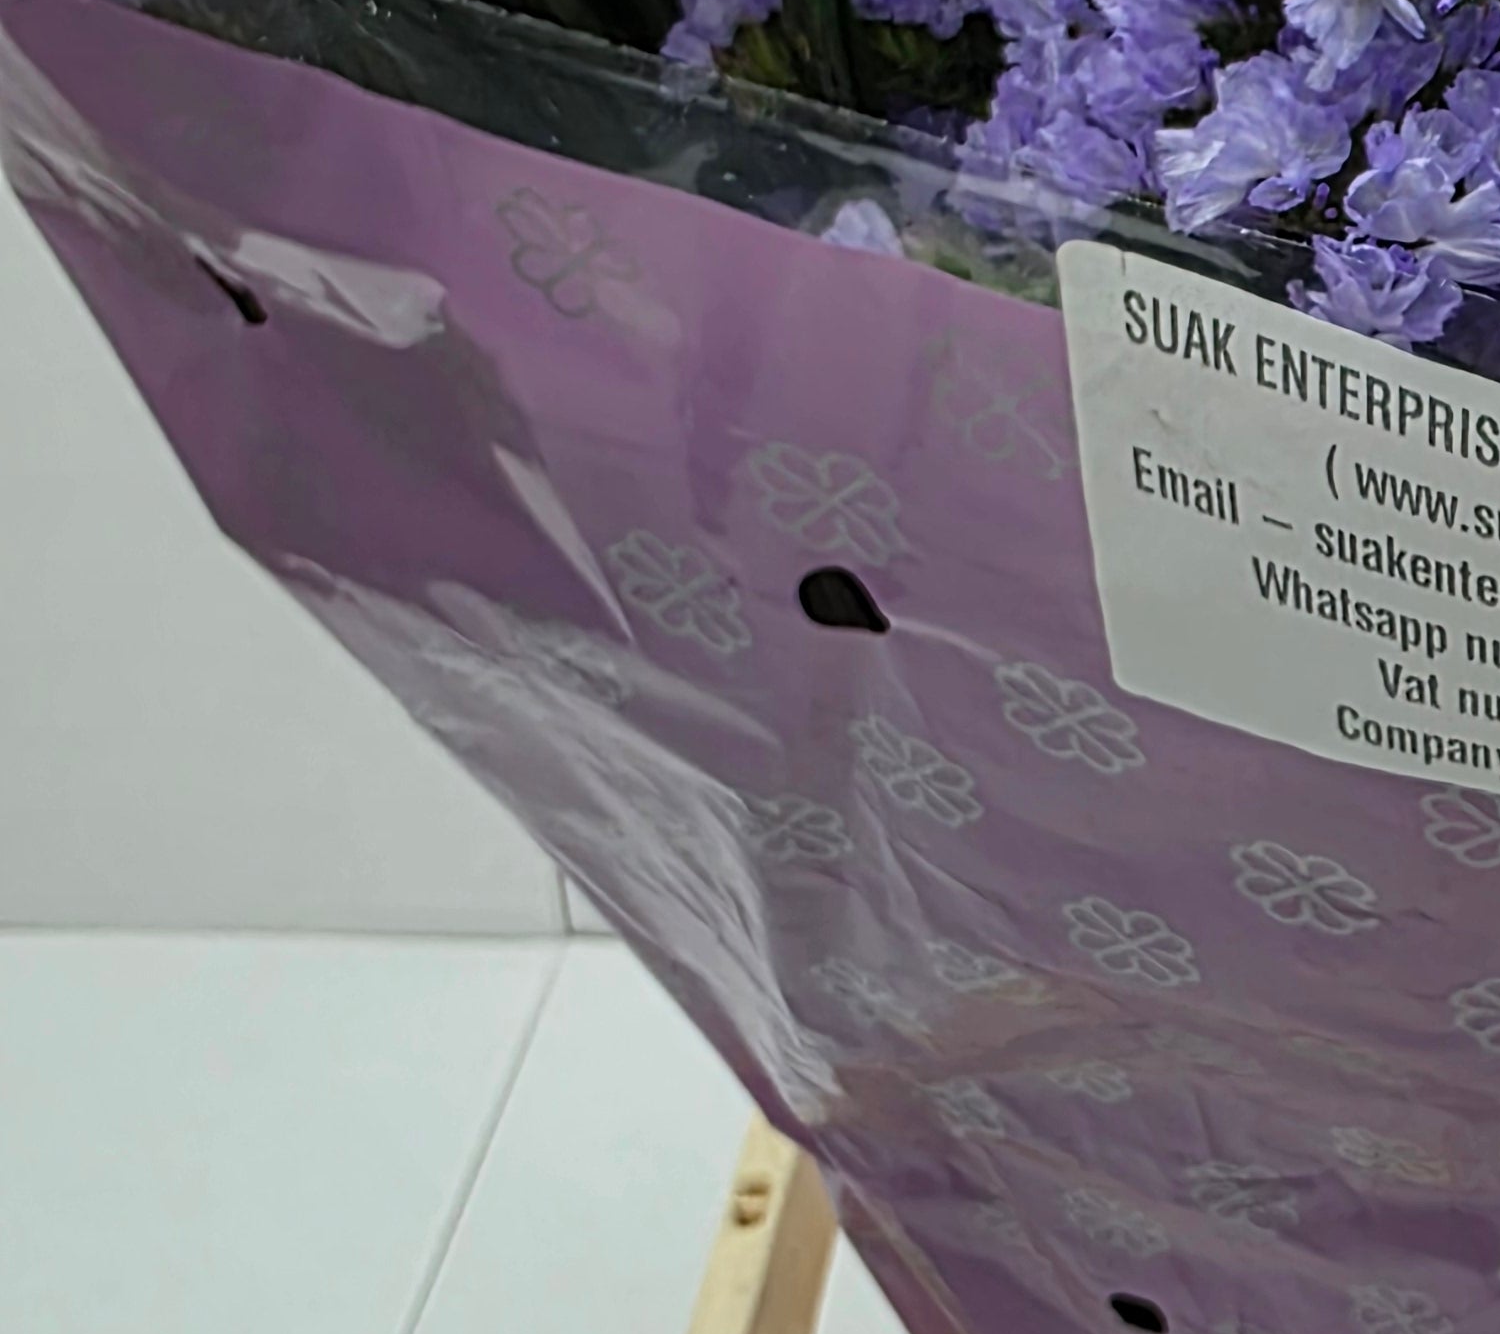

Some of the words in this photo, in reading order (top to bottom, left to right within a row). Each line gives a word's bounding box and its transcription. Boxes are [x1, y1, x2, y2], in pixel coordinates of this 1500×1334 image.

[1123, 289, 1237, 376] SUAK
[1132, 446, 1239, 526] Email
[1252, 557, 1449, 660] Whatsapp
[1377, 659, 1440, 708] Vat
